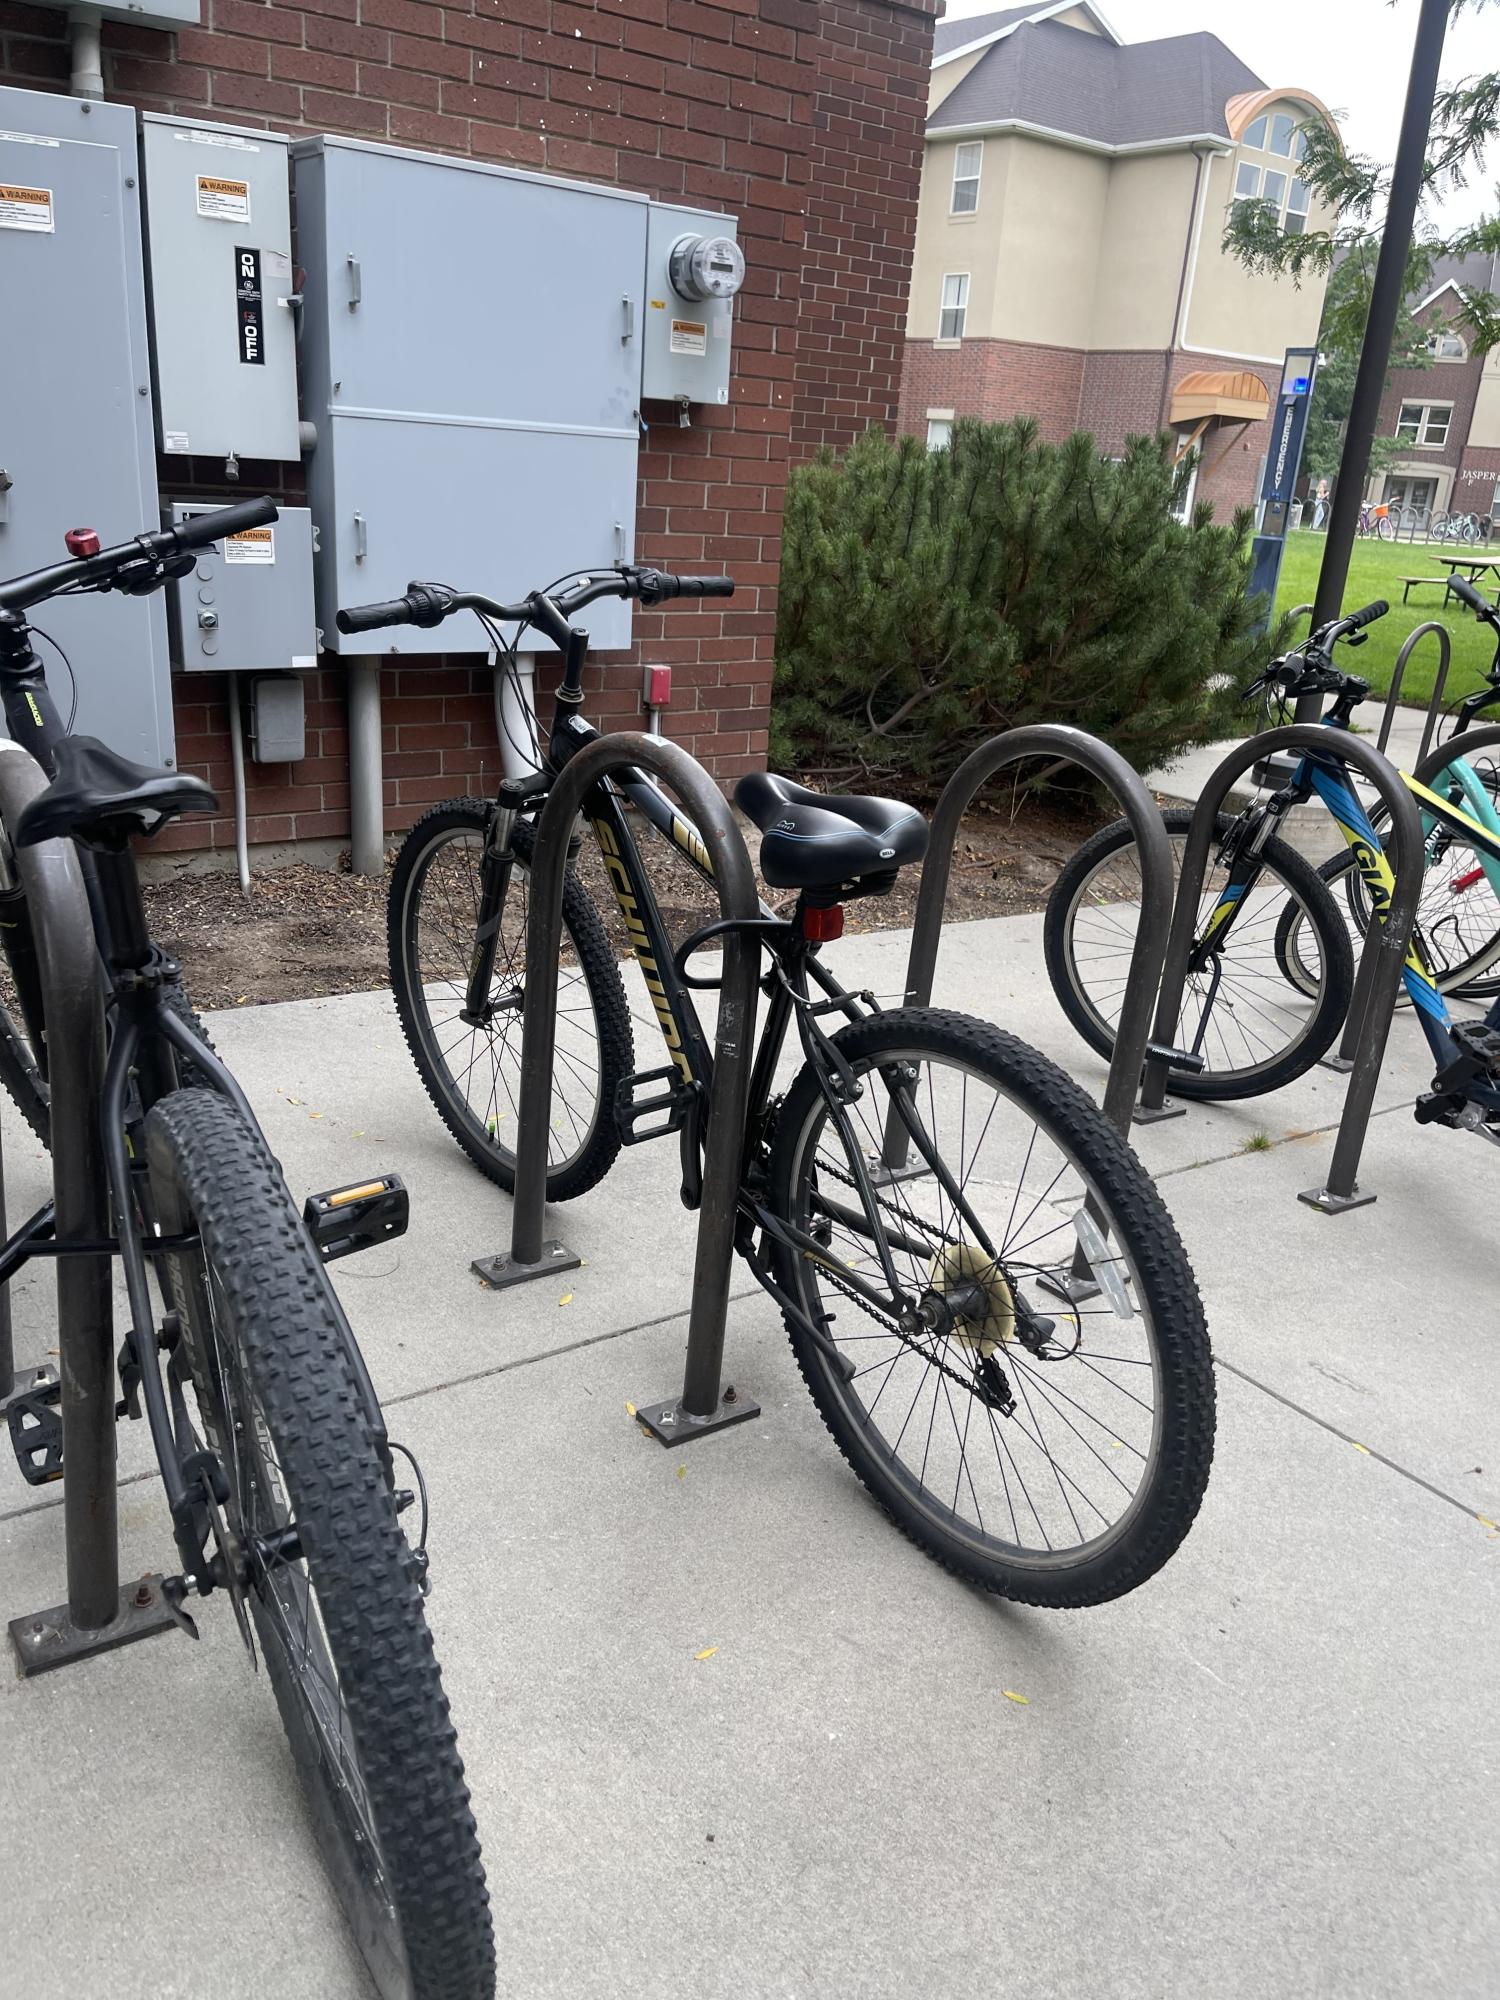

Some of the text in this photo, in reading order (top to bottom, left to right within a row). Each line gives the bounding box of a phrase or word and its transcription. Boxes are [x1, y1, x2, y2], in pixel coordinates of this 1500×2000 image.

[7, 190, 49, 202] WARNING
[209, 181, 246, 194] WARNING
[241, 254, 255, 278] ON
[245, 325, 258, 360] OFF
[1274, 406, 1294, 490] EMERGENCY
[1460, 470, 1496, 480] JASPER
[236, 532, 271, 541] WARNING
[591, 818, 693, 1084] SCHWINN
